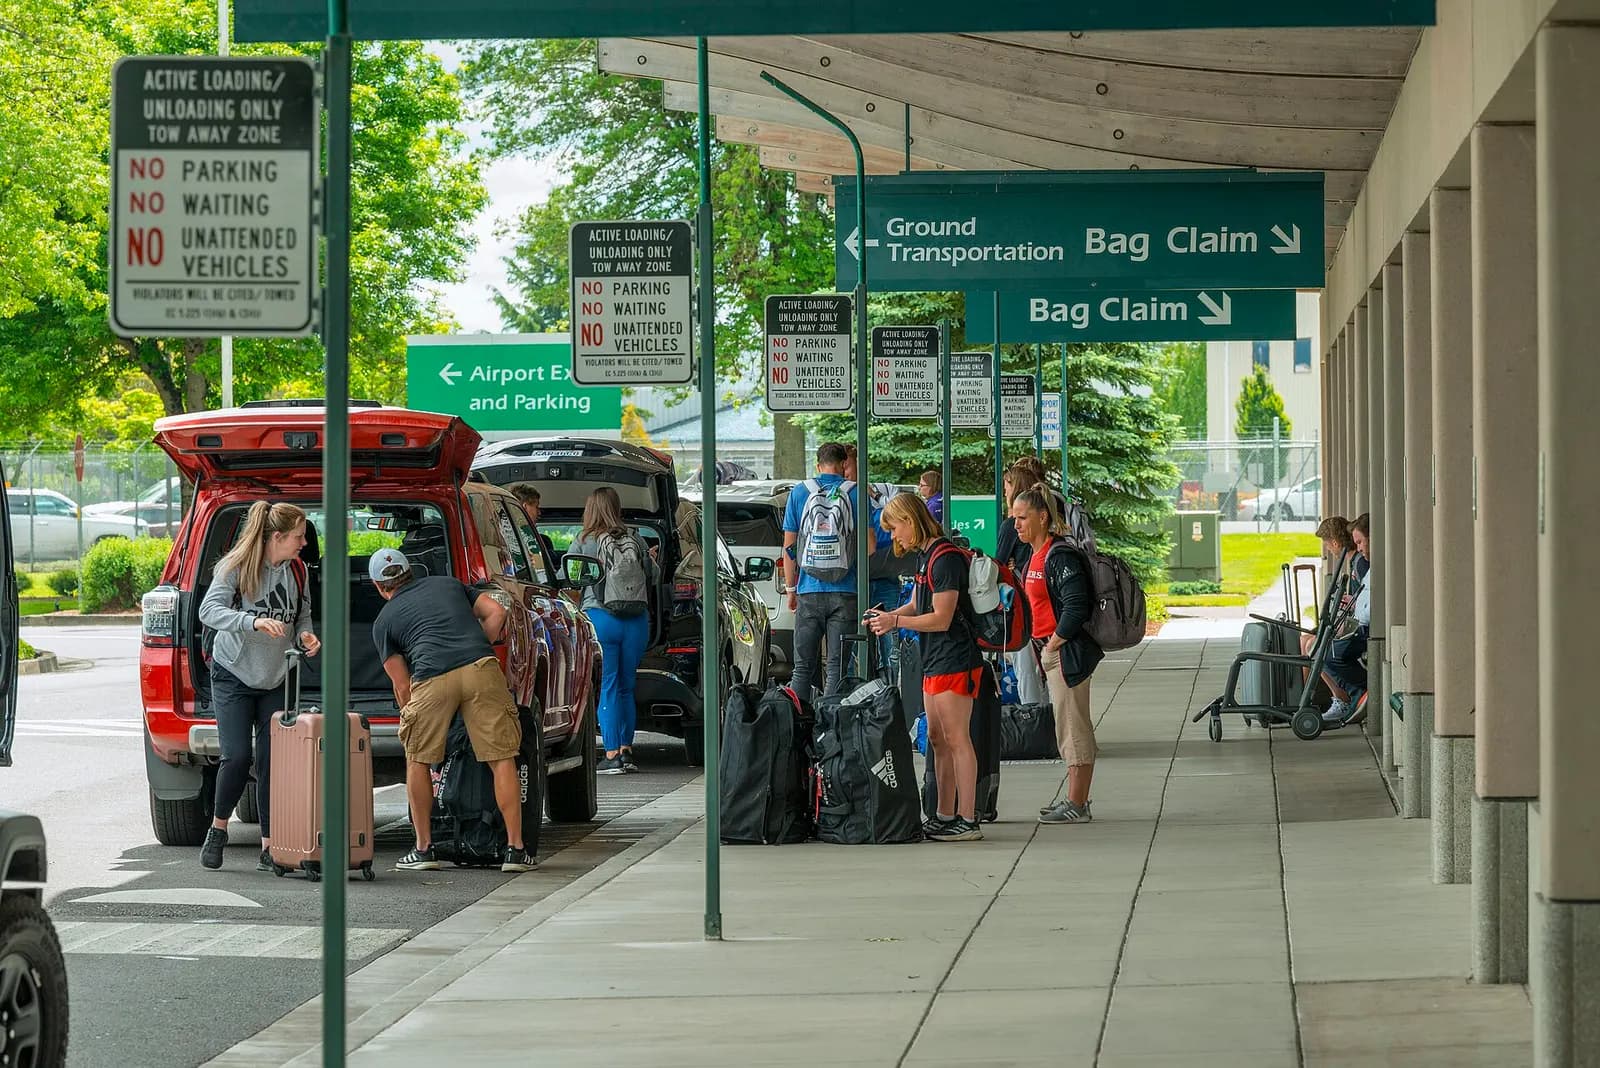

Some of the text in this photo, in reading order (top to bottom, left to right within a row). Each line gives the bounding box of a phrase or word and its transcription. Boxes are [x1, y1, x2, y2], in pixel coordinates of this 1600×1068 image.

[144, 70, 286, 92] ACTIVE LOADING/
[144, 100, 284, 120] UNLOADING ONLY
[148, 126, 281, 144] TOW AWAY ZONE
[129, 158, 278, 182] NO PARKING
[129, 192, 270, 216] NO WAITING
[589, 228, 674, 242] ACTIVE LOADING/
[886, 217, 976, 238] Ground
[128, 227, 297, 267] NO UNATTENDED
[589, 246, 672, 259] UNLOADING ONLY
[1085, 226, 1258, 262] Bag Claim
[886, 242, 1064, 267] Transportation
[182, 256, 289, 278] VEHICLES
[592, 261, 672, 273] TOW AWAY ZONE
[582, 281, 671, 296] NO PARKING
[582, 302, 666, 316] NO WAITING
[779, 301, 840, 310] ACTIVE LOADING/
[1029, 296, 1188, 329] Bag Claim
[779, 313, 838, 322] UNLOADING ONLY
[581, 322, 683, 347] NO UNATTENDED
[773, 338, 836, 348] NO PARKING
[615, 338, 678, 352] VEHICLES
[585, 358, 616, 366] VIOLATORS
[642, 358, 662, 366] CITED/
[664, 358, 683, 366] TOWED
[773, 352, 834, 362] NO WAITING
[469, 365, 572, 386] Airport Ex
[772, 366, 845, 384] NO UNATTENDED
[878, 370, 890, 378] NO
[796, 379, 842, 388] VEHICLES
[876, 382, 890, 396] NO
[469, 394, 592, 413] and Parking
[895, 392, 931, 400] VEHICLES
[886, 750, 898, 788] adidas
[519, 764, 528, 803] adidas
